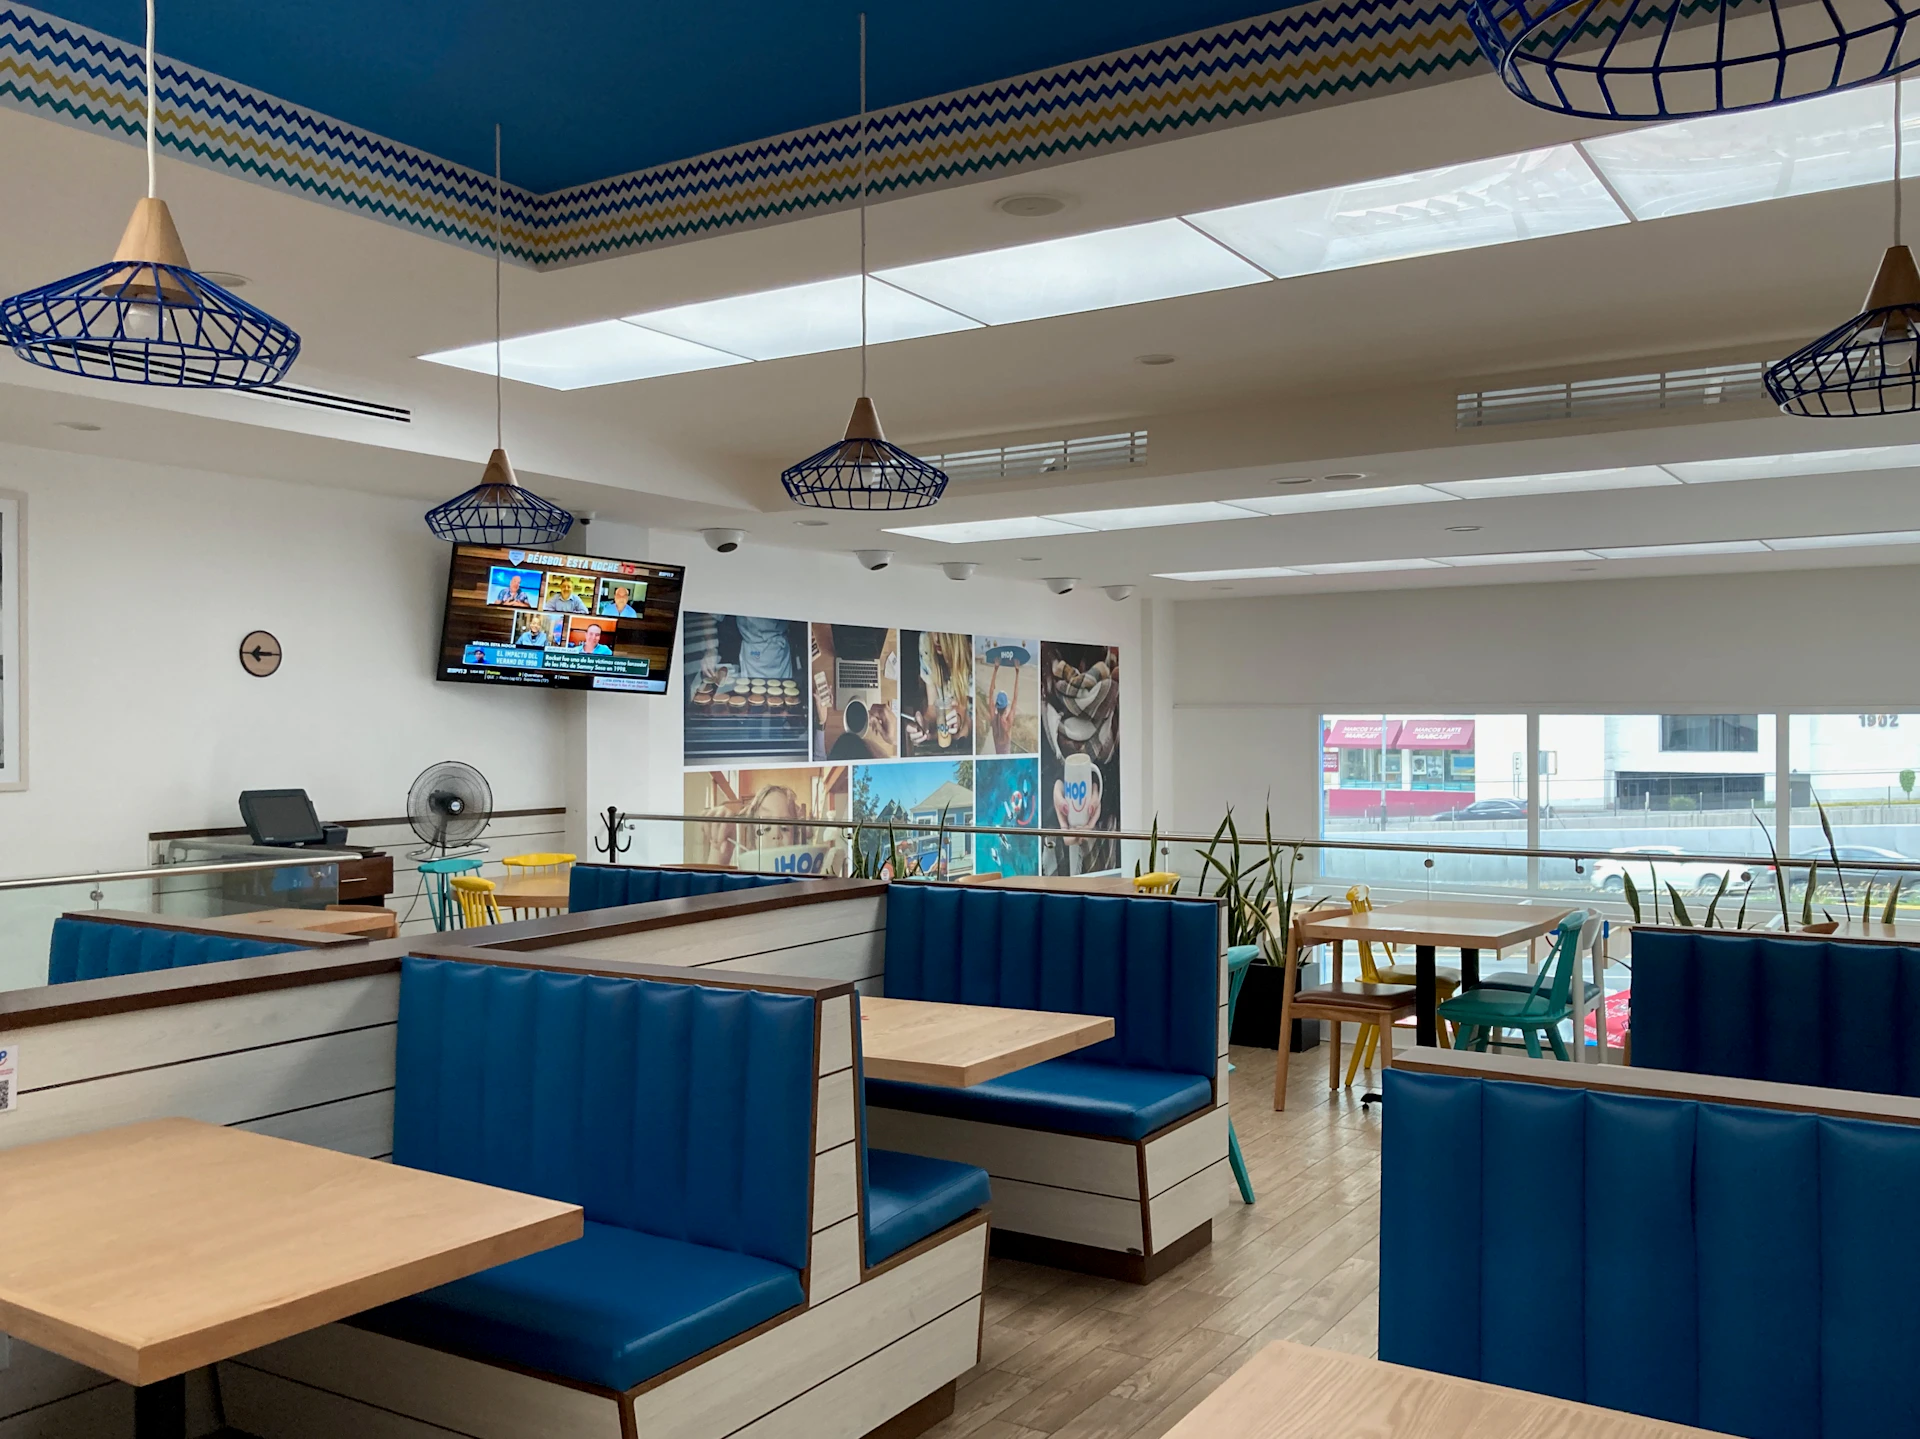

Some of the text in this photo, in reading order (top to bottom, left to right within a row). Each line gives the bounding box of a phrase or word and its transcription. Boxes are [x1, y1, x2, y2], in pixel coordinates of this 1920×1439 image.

[526, 551, 564, 566] BÉISBOL
[566, 558, 589, 570] ESTA
[590, 560, 619, 573] NOCHE
[496, 657, 516, 665] VERANO
[504, 650, 527, 659] IMPACTO
[528, 652, 538, 660] DEL
[1858, 714, 1899, 728] 1902
